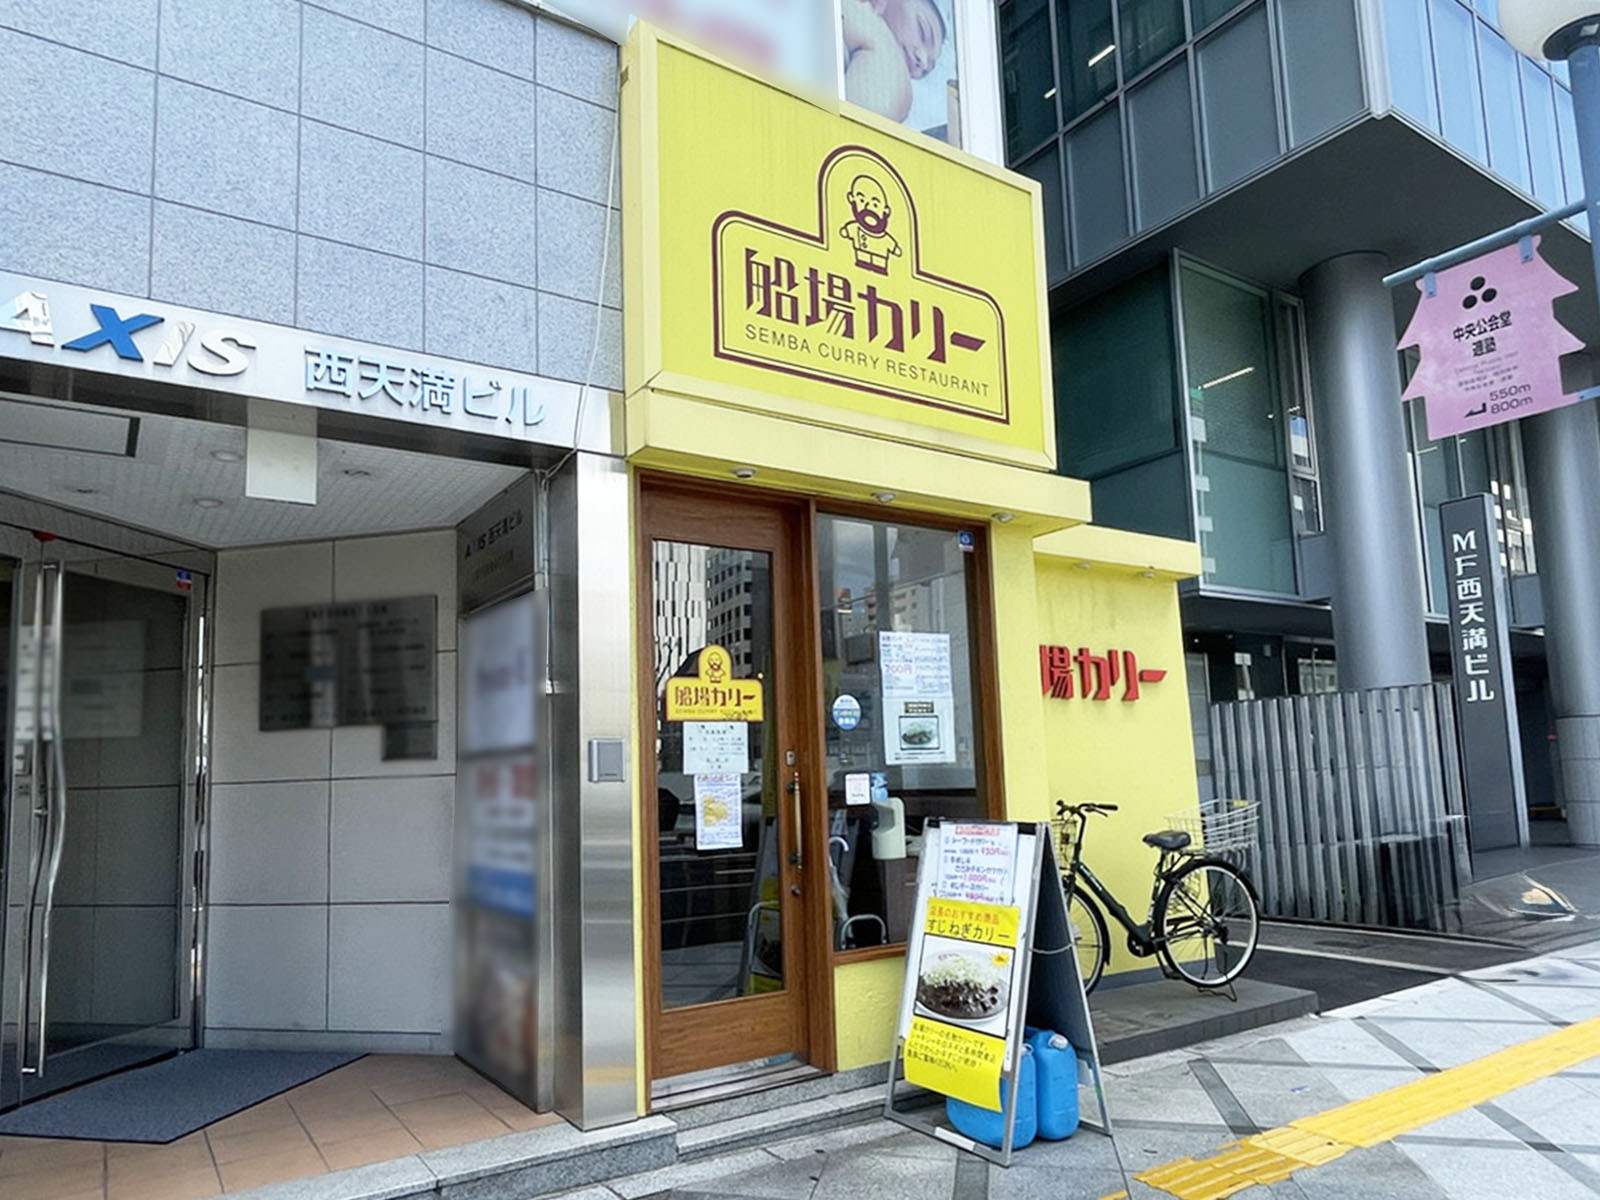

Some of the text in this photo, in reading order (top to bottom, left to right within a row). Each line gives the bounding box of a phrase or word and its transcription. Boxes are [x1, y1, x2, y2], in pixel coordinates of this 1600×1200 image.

[745, 247, 987, 364] 船場カリー
[1453, 310, 1512, 341] 中央公会堂
[745, 324, 990, 397] SEMBA CURRY RESTAURANT
[304, 344, 546, 427] 西天満ビル
[1489, 384, 1532, 401] 550m
[1490, 396, 1534, 415] 800m
[1453, 530, 1495, 702] MF西天満ビル
[675, 686, 756, 707] 船場カリー
[927, 918, 1010, 941] すじねぎカリー
